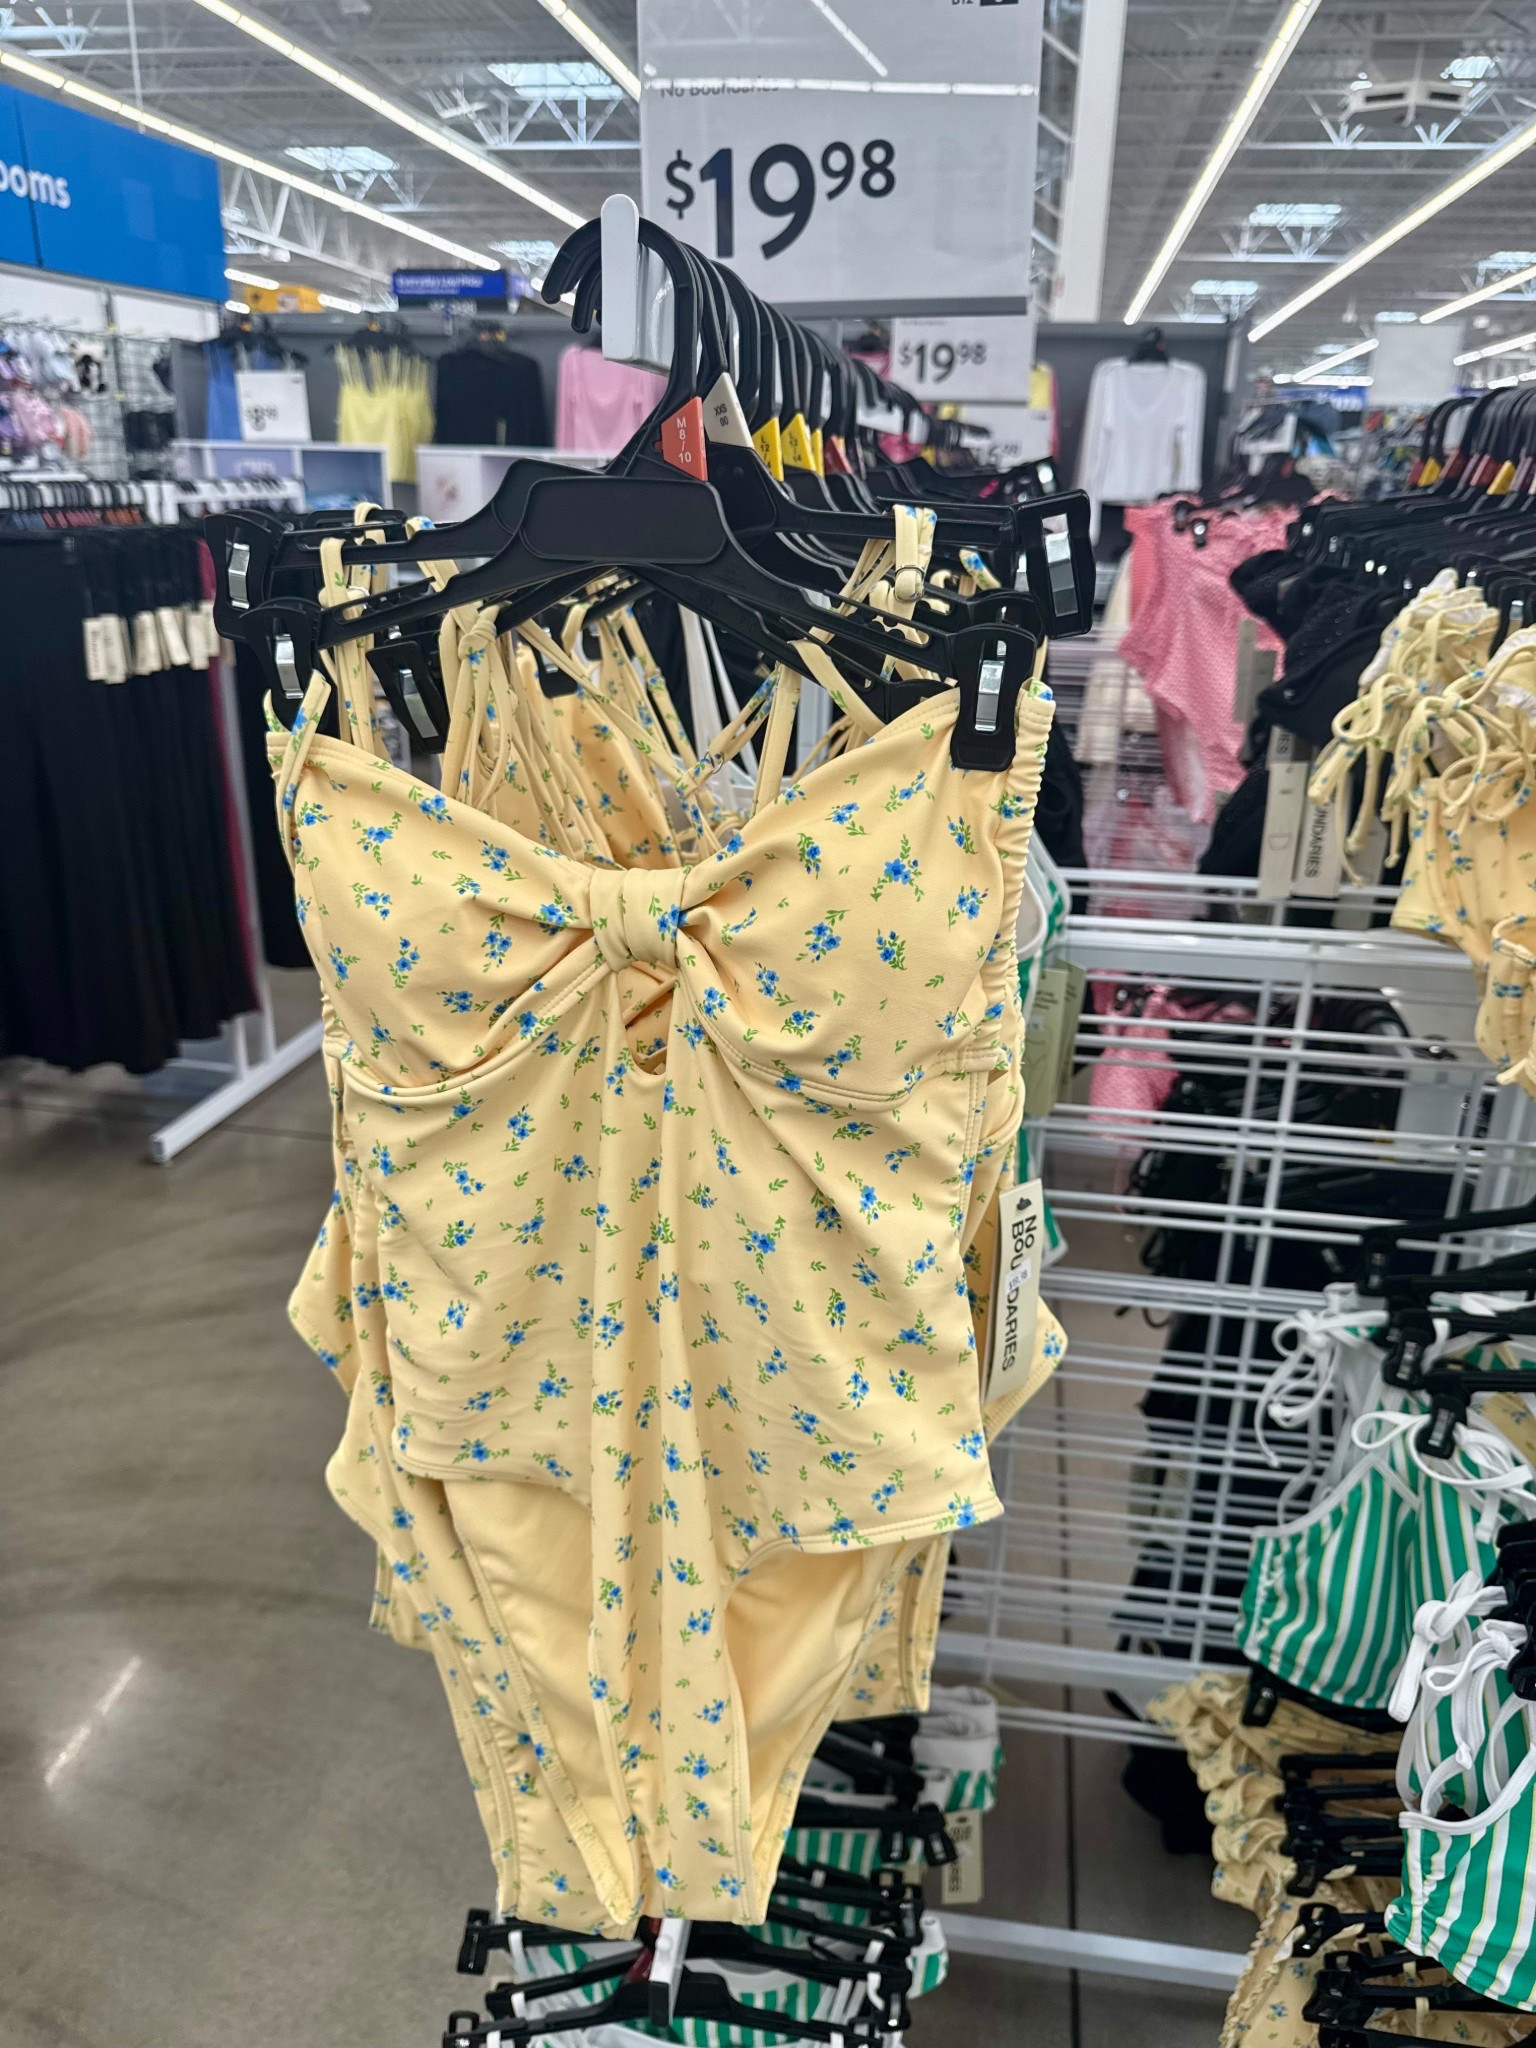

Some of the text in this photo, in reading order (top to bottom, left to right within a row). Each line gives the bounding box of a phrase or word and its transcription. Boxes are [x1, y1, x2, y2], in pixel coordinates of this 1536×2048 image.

[713, 403, 727, 416] XXS
[676, 416, 687, 429] M
[678, 451, 692, 463] 10
[1023, 1214, 1037, 1249] NO
[1002, 1221, 1025, 1372] BOUDARIES
